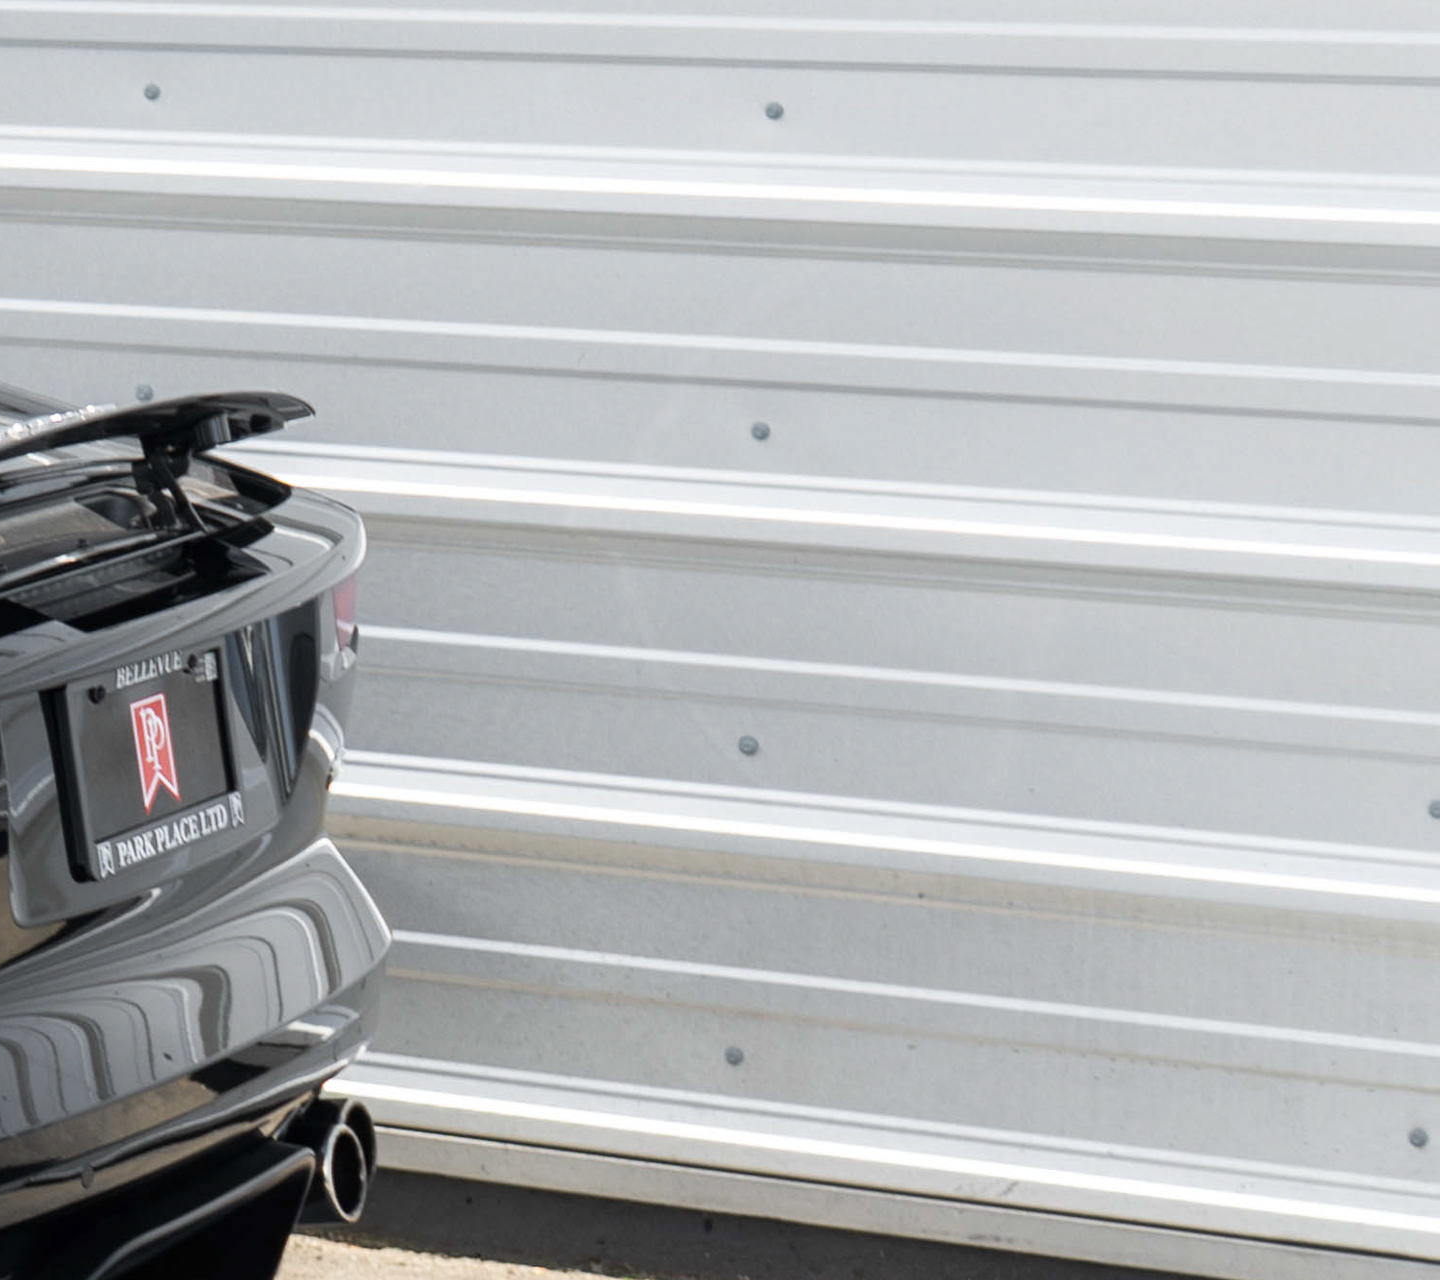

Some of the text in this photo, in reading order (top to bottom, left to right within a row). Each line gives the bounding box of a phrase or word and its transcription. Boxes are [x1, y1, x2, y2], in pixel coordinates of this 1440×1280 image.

[116, 803, 228, 867] PARK PLACE LTD
